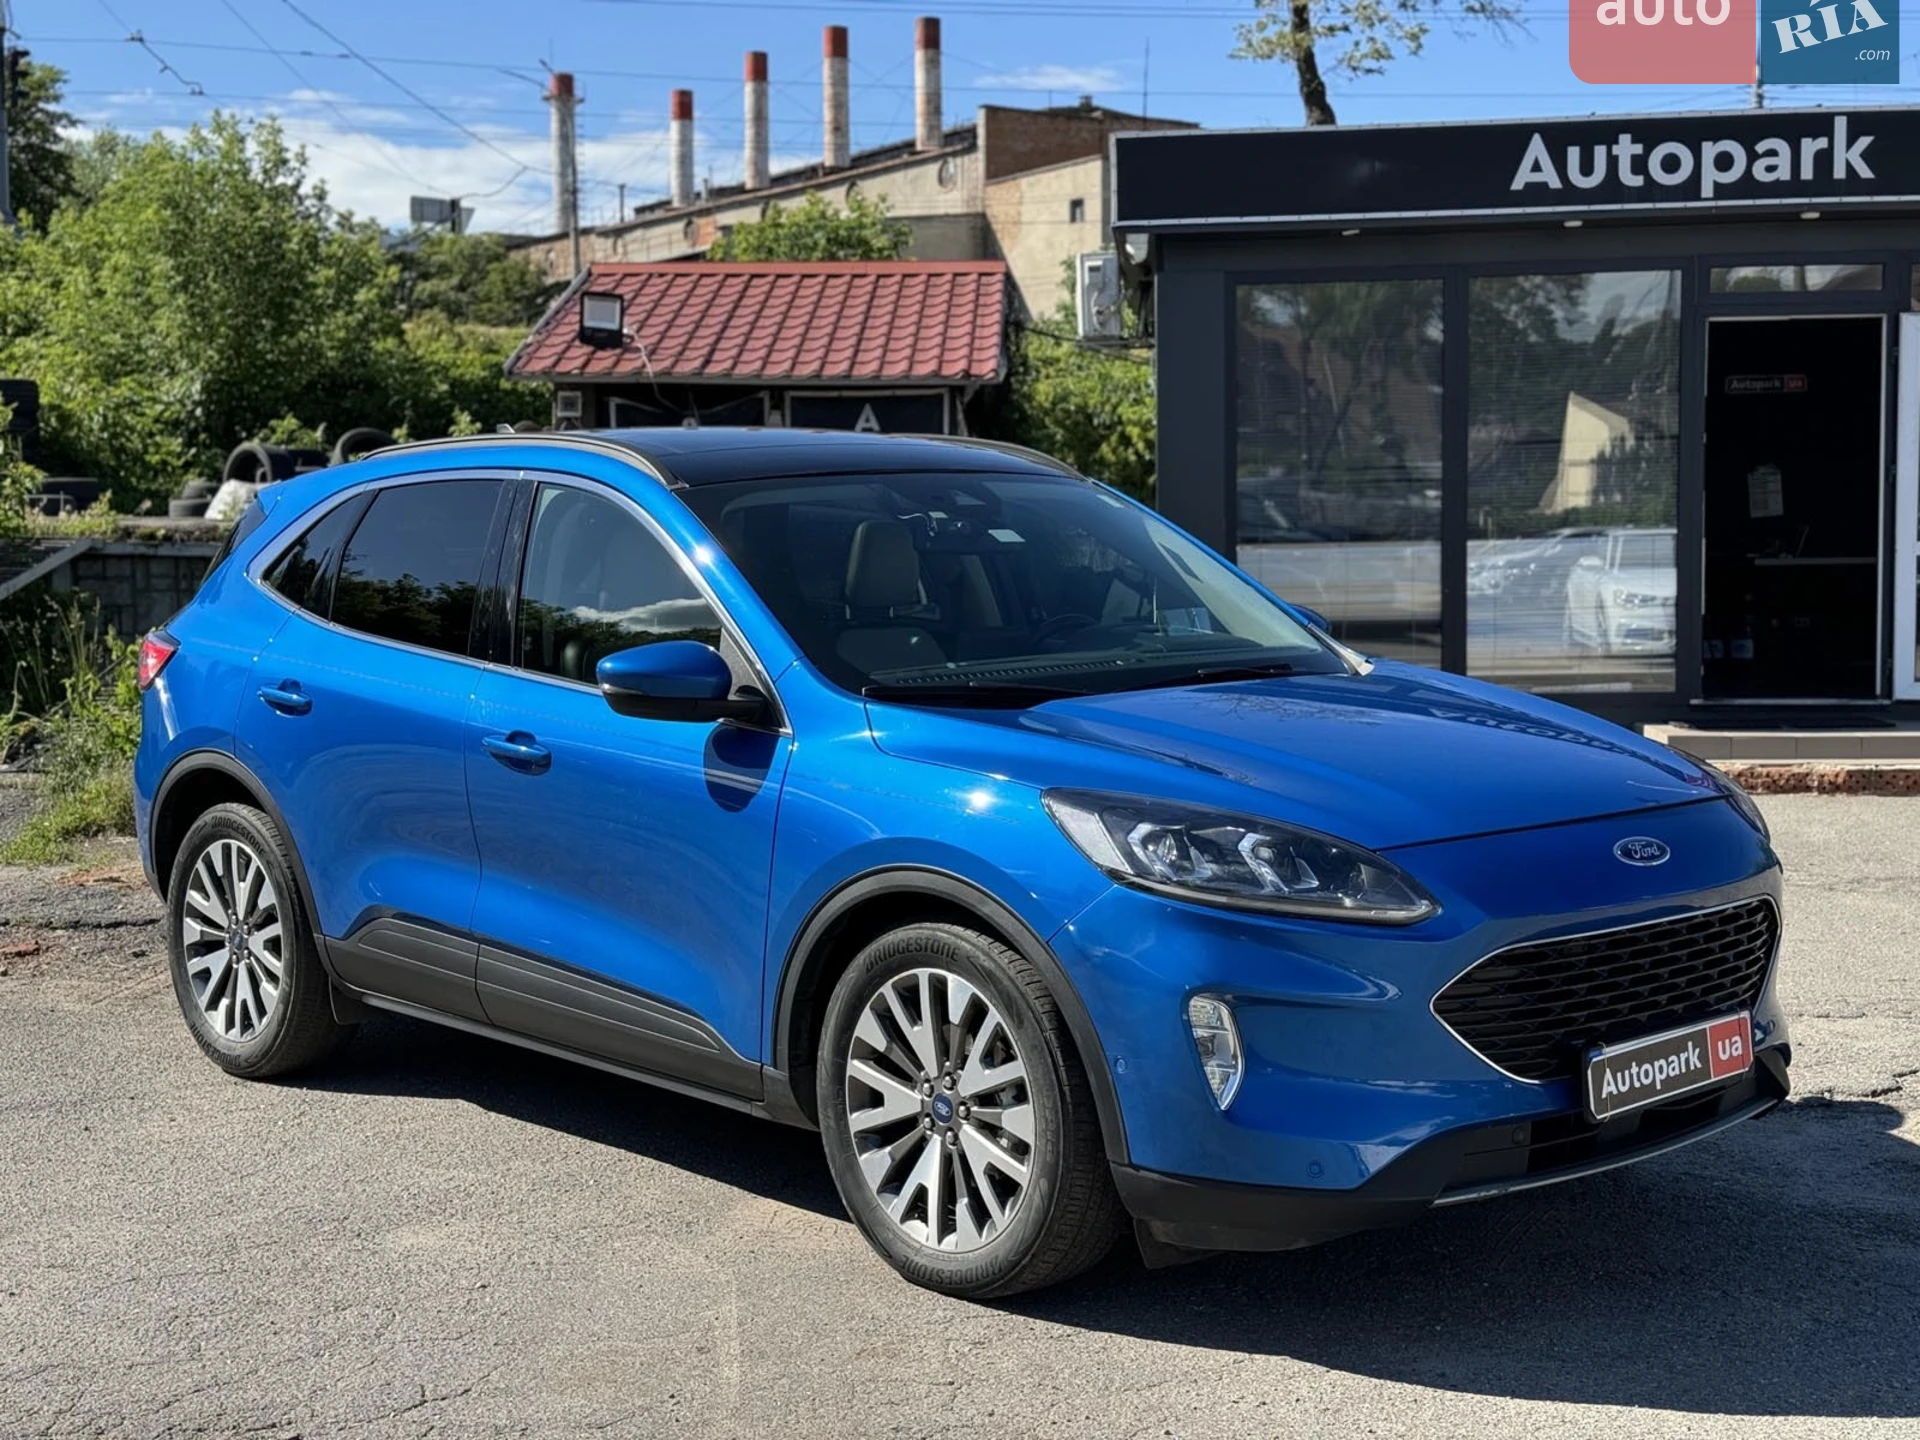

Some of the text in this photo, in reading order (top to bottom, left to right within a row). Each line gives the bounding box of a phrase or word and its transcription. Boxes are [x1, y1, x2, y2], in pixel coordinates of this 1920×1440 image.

[1509, 115, 1876, 199] Autopark
[1628, 841, 1661, 859] Ford
[863, 936, 961, 976] BRIDGESTONE
[1601, 1035, 1743, 1099] Autopark ua
